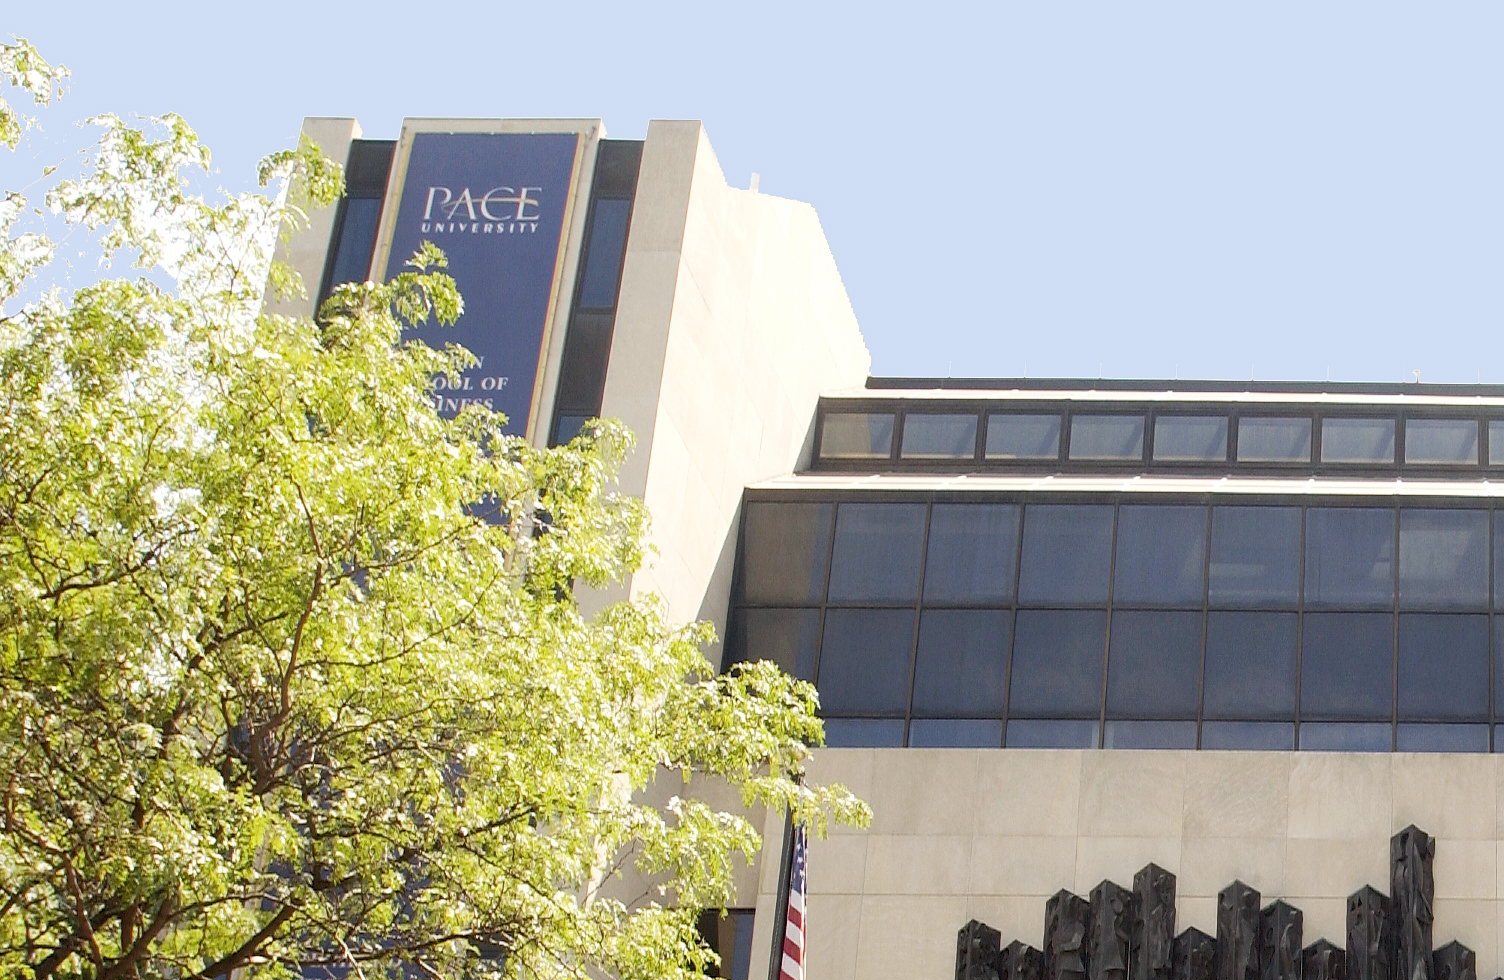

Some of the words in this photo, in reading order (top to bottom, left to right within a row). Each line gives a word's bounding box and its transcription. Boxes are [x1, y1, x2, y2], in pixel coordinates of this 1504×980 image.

[423, 186, 542, 221] PACE
[421, 222, 538, 233] UNIVERSITY
[481, 376, 509, 391] OF
